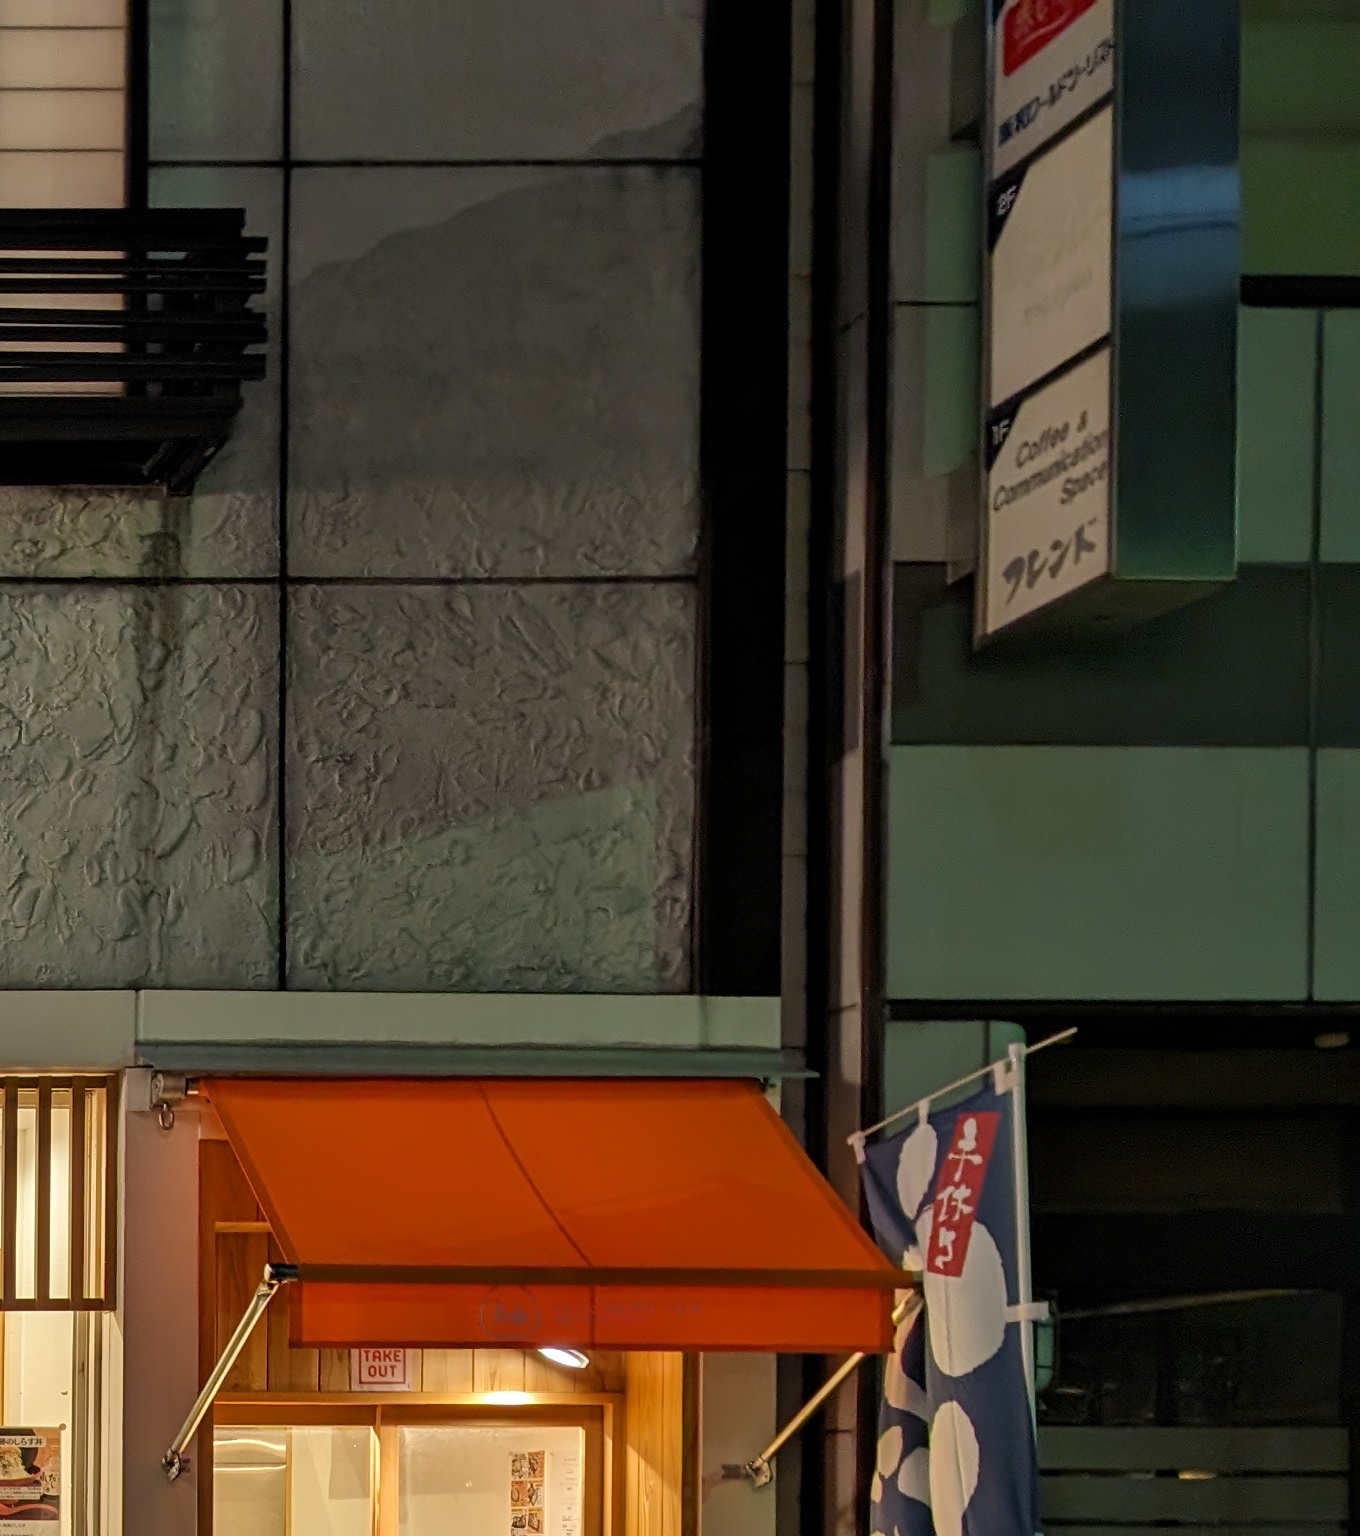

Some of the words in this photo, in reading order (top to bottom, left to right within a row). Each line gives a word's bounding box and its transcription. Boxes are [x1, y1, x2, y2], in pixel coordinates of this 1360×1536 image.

[1016, 421, 1070, 468] Coffee
[1003, 517, 1098, 605] フレンド
[363, 1349, 402, 1363] TAKE
[368, 1364, 397, 1378] OUT
